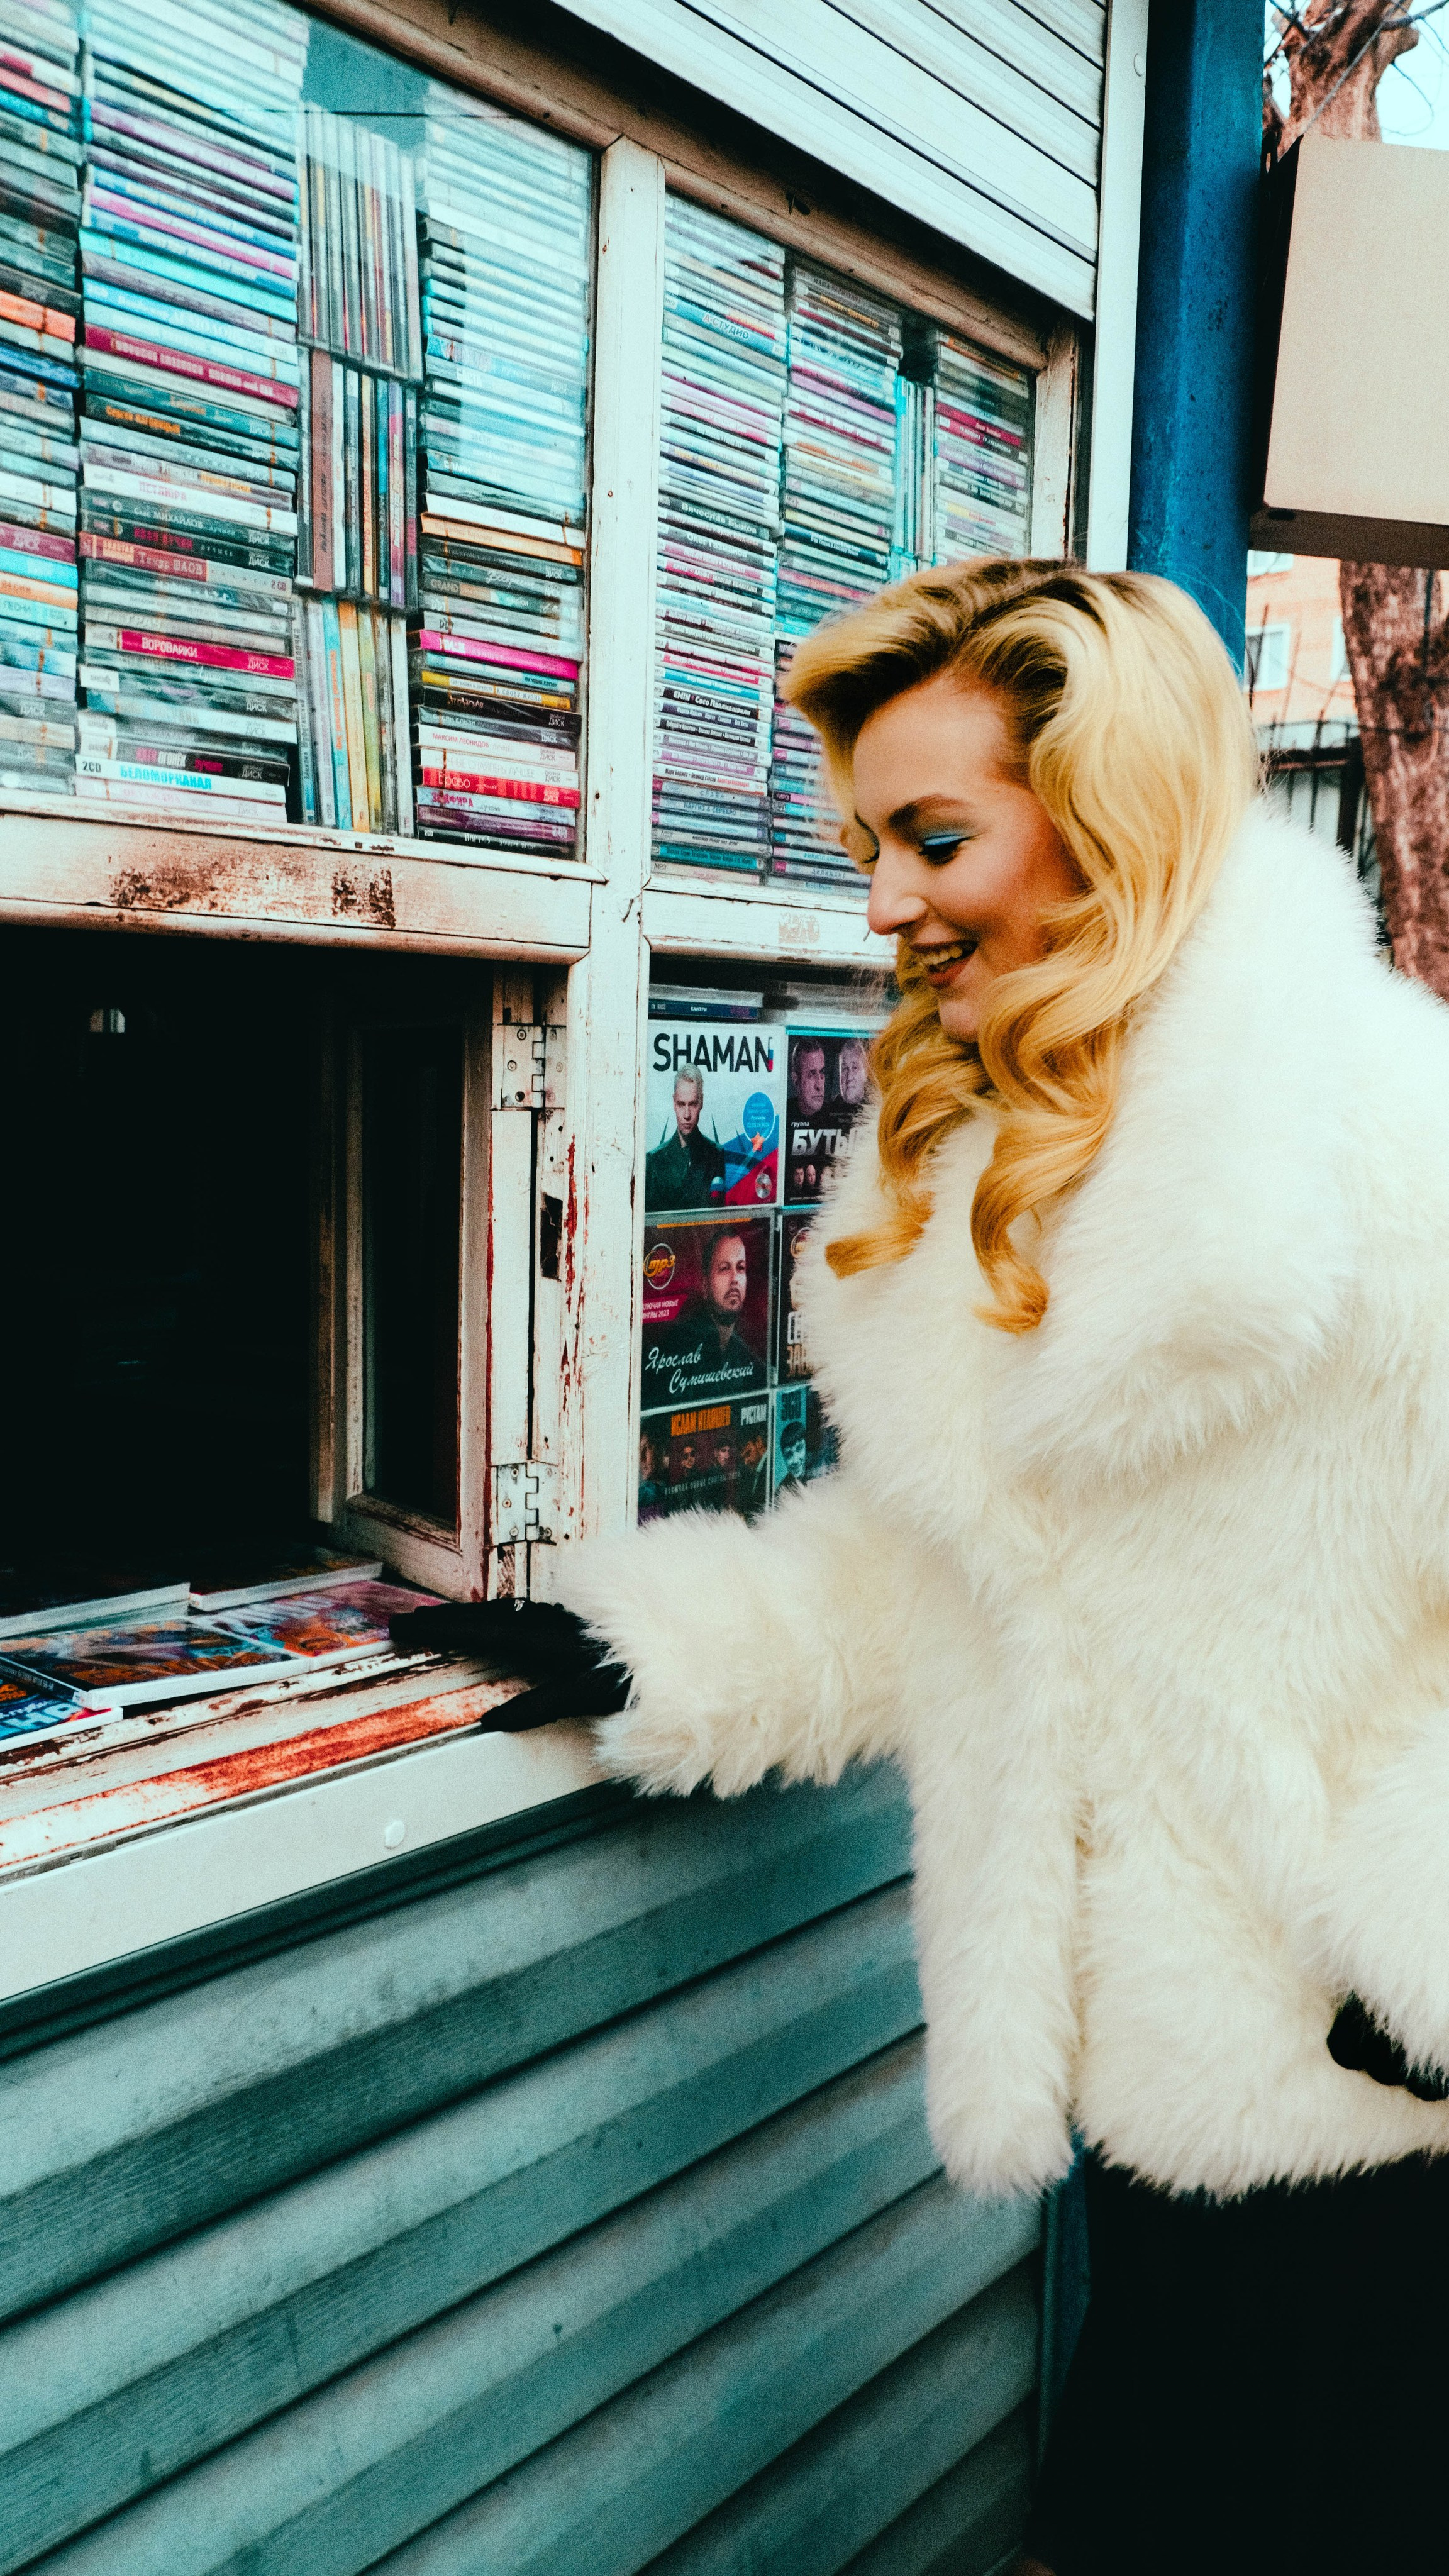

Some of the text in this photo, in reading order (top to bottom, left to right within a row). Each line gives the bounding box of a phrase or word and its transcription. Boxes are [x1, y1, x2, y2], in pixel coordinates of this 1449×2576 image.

[702, 314, 750, 340] А-СТУДИО
[153, 511, 203, 530] МИХАЙЛОВ
[681, 502, 725, 525] Вячеслав
[728, 517, 757, 535] Быков
[248, 556, 270, 567] ДИСК
[142, 636, 199, 658] ВОРОВАЙКИ
[247, 660, 269, 671] ДИСК
[496, 687, 502, 695] К
[502, 689, 521, 699] СЛОВУ
[673, 691, 691, 702] EMIN
[246, 701, 267, 713] ДИСК
[548, 718, 565, 727] ДИСК
[432, 733, 458, 743] МАКСИМ
[458, 737, 489, 748] ЛЕОНИДОВ
[541, 734, 558, 743] ДИСК
[540, 753, 556, 762] ДИСК
[82, 760, 102, 774] 2CD
[119, 765, 213, 790] БЕЛОМОРКАНАЛ
[242, 770, 262, 780] ДИСК
[545, 775, 561, 783] ДИСК
[543, 793, 560, 803] ДИСК
[712, 806, 737, 816] СЕРЕБРО
[653, 1033, 774, 1073] SHAMAN
[644, 1254, 676, 1277] mp3
[662, 1299, 679, 1308] НОВЫЕ
[645, 1343, 703, 1374] Ярослав
[669, 1362, 754, 1394] Сумишевский
[741, 1403, 767, 1426] РУСТАМ
[671, 1411, 697, 1438] ИСЛАМ
